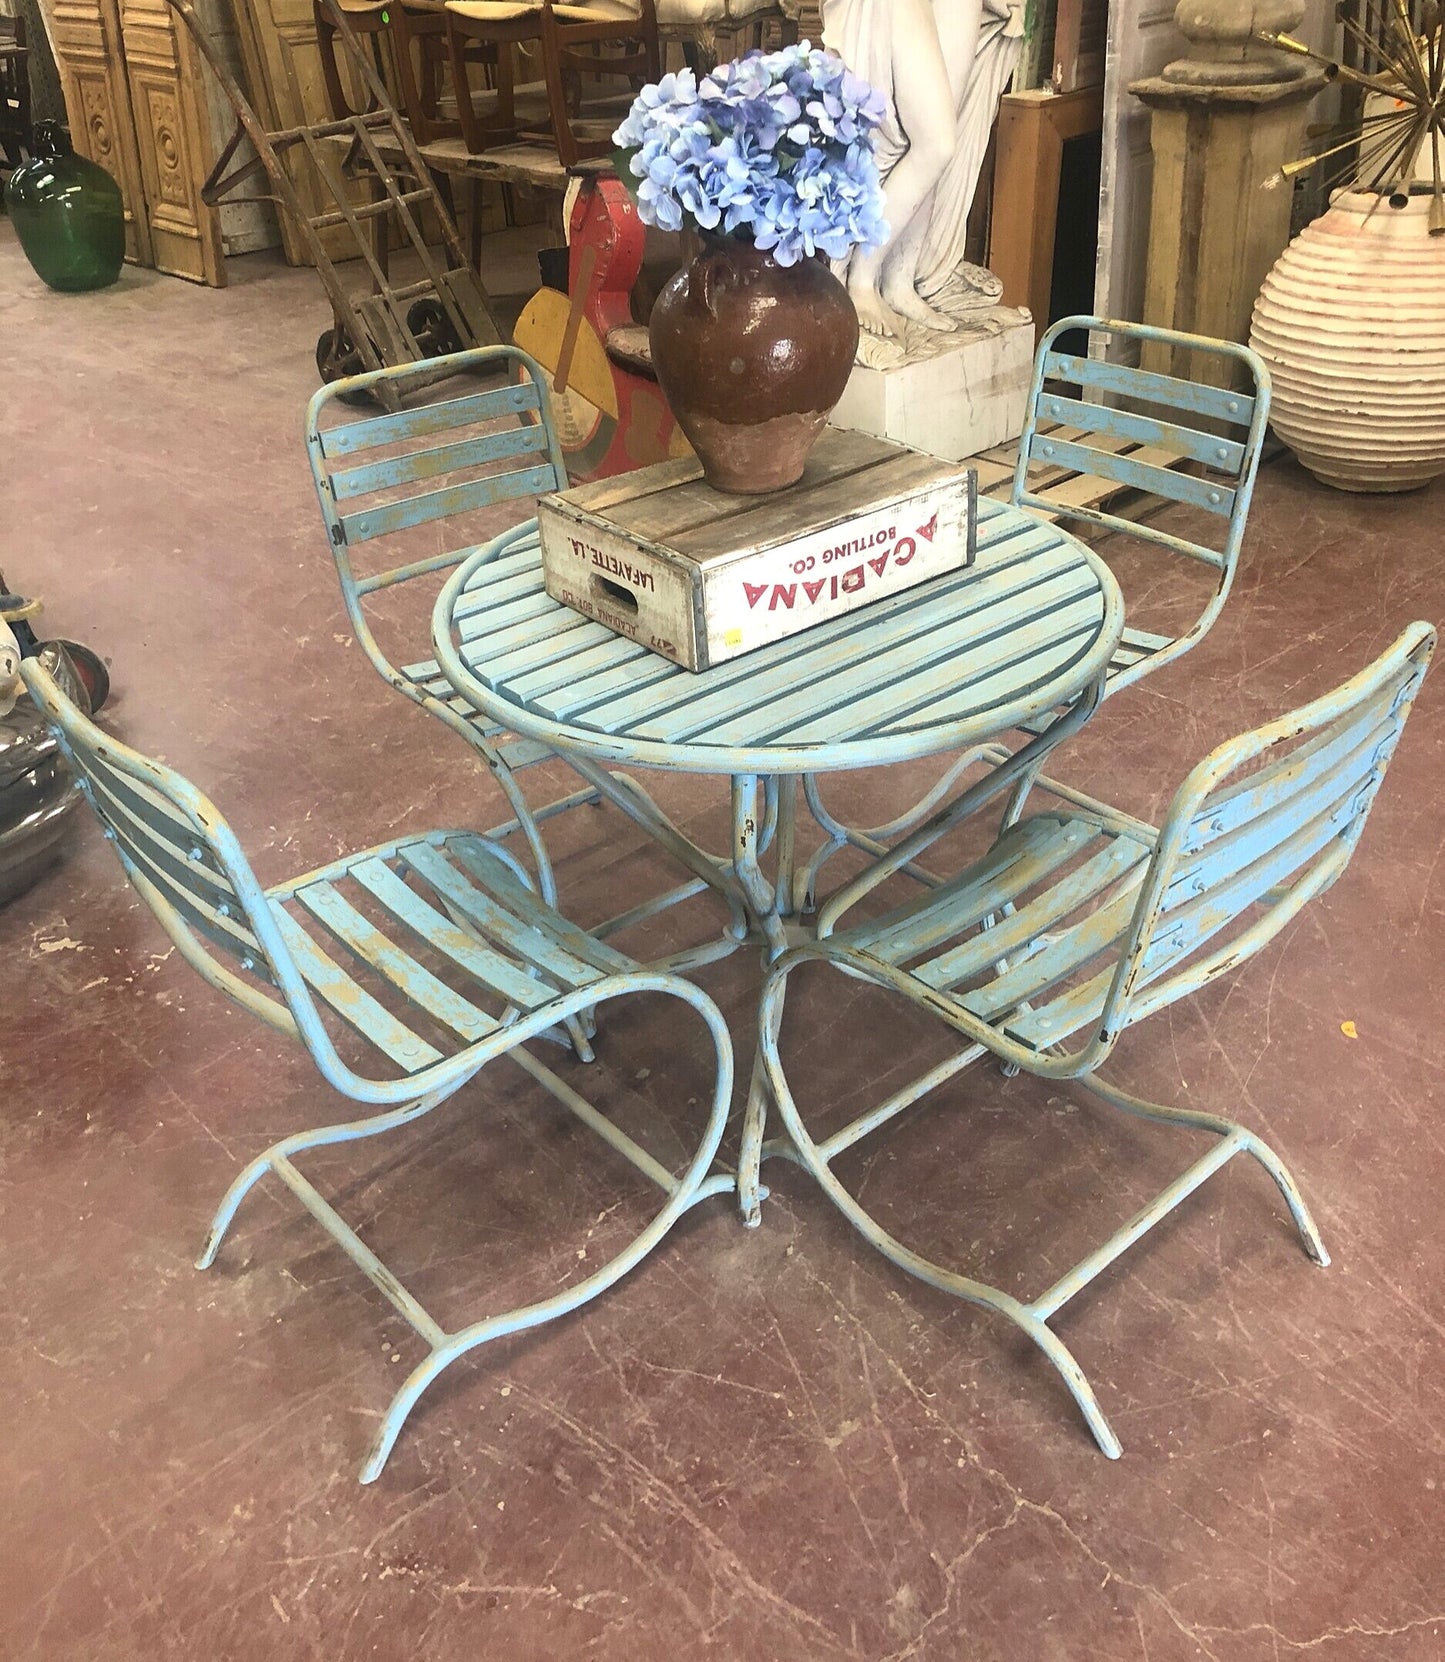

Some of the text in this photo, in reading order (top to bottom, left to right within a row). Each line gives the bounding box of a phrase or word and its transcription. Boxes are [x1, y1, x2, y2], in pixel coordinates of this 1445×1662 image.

[743, 513, 937, 611] ACADIANA
[788, 527, 896, 575] BOTTLING CO.
[597, 607, 636, 635] ACADIANA
